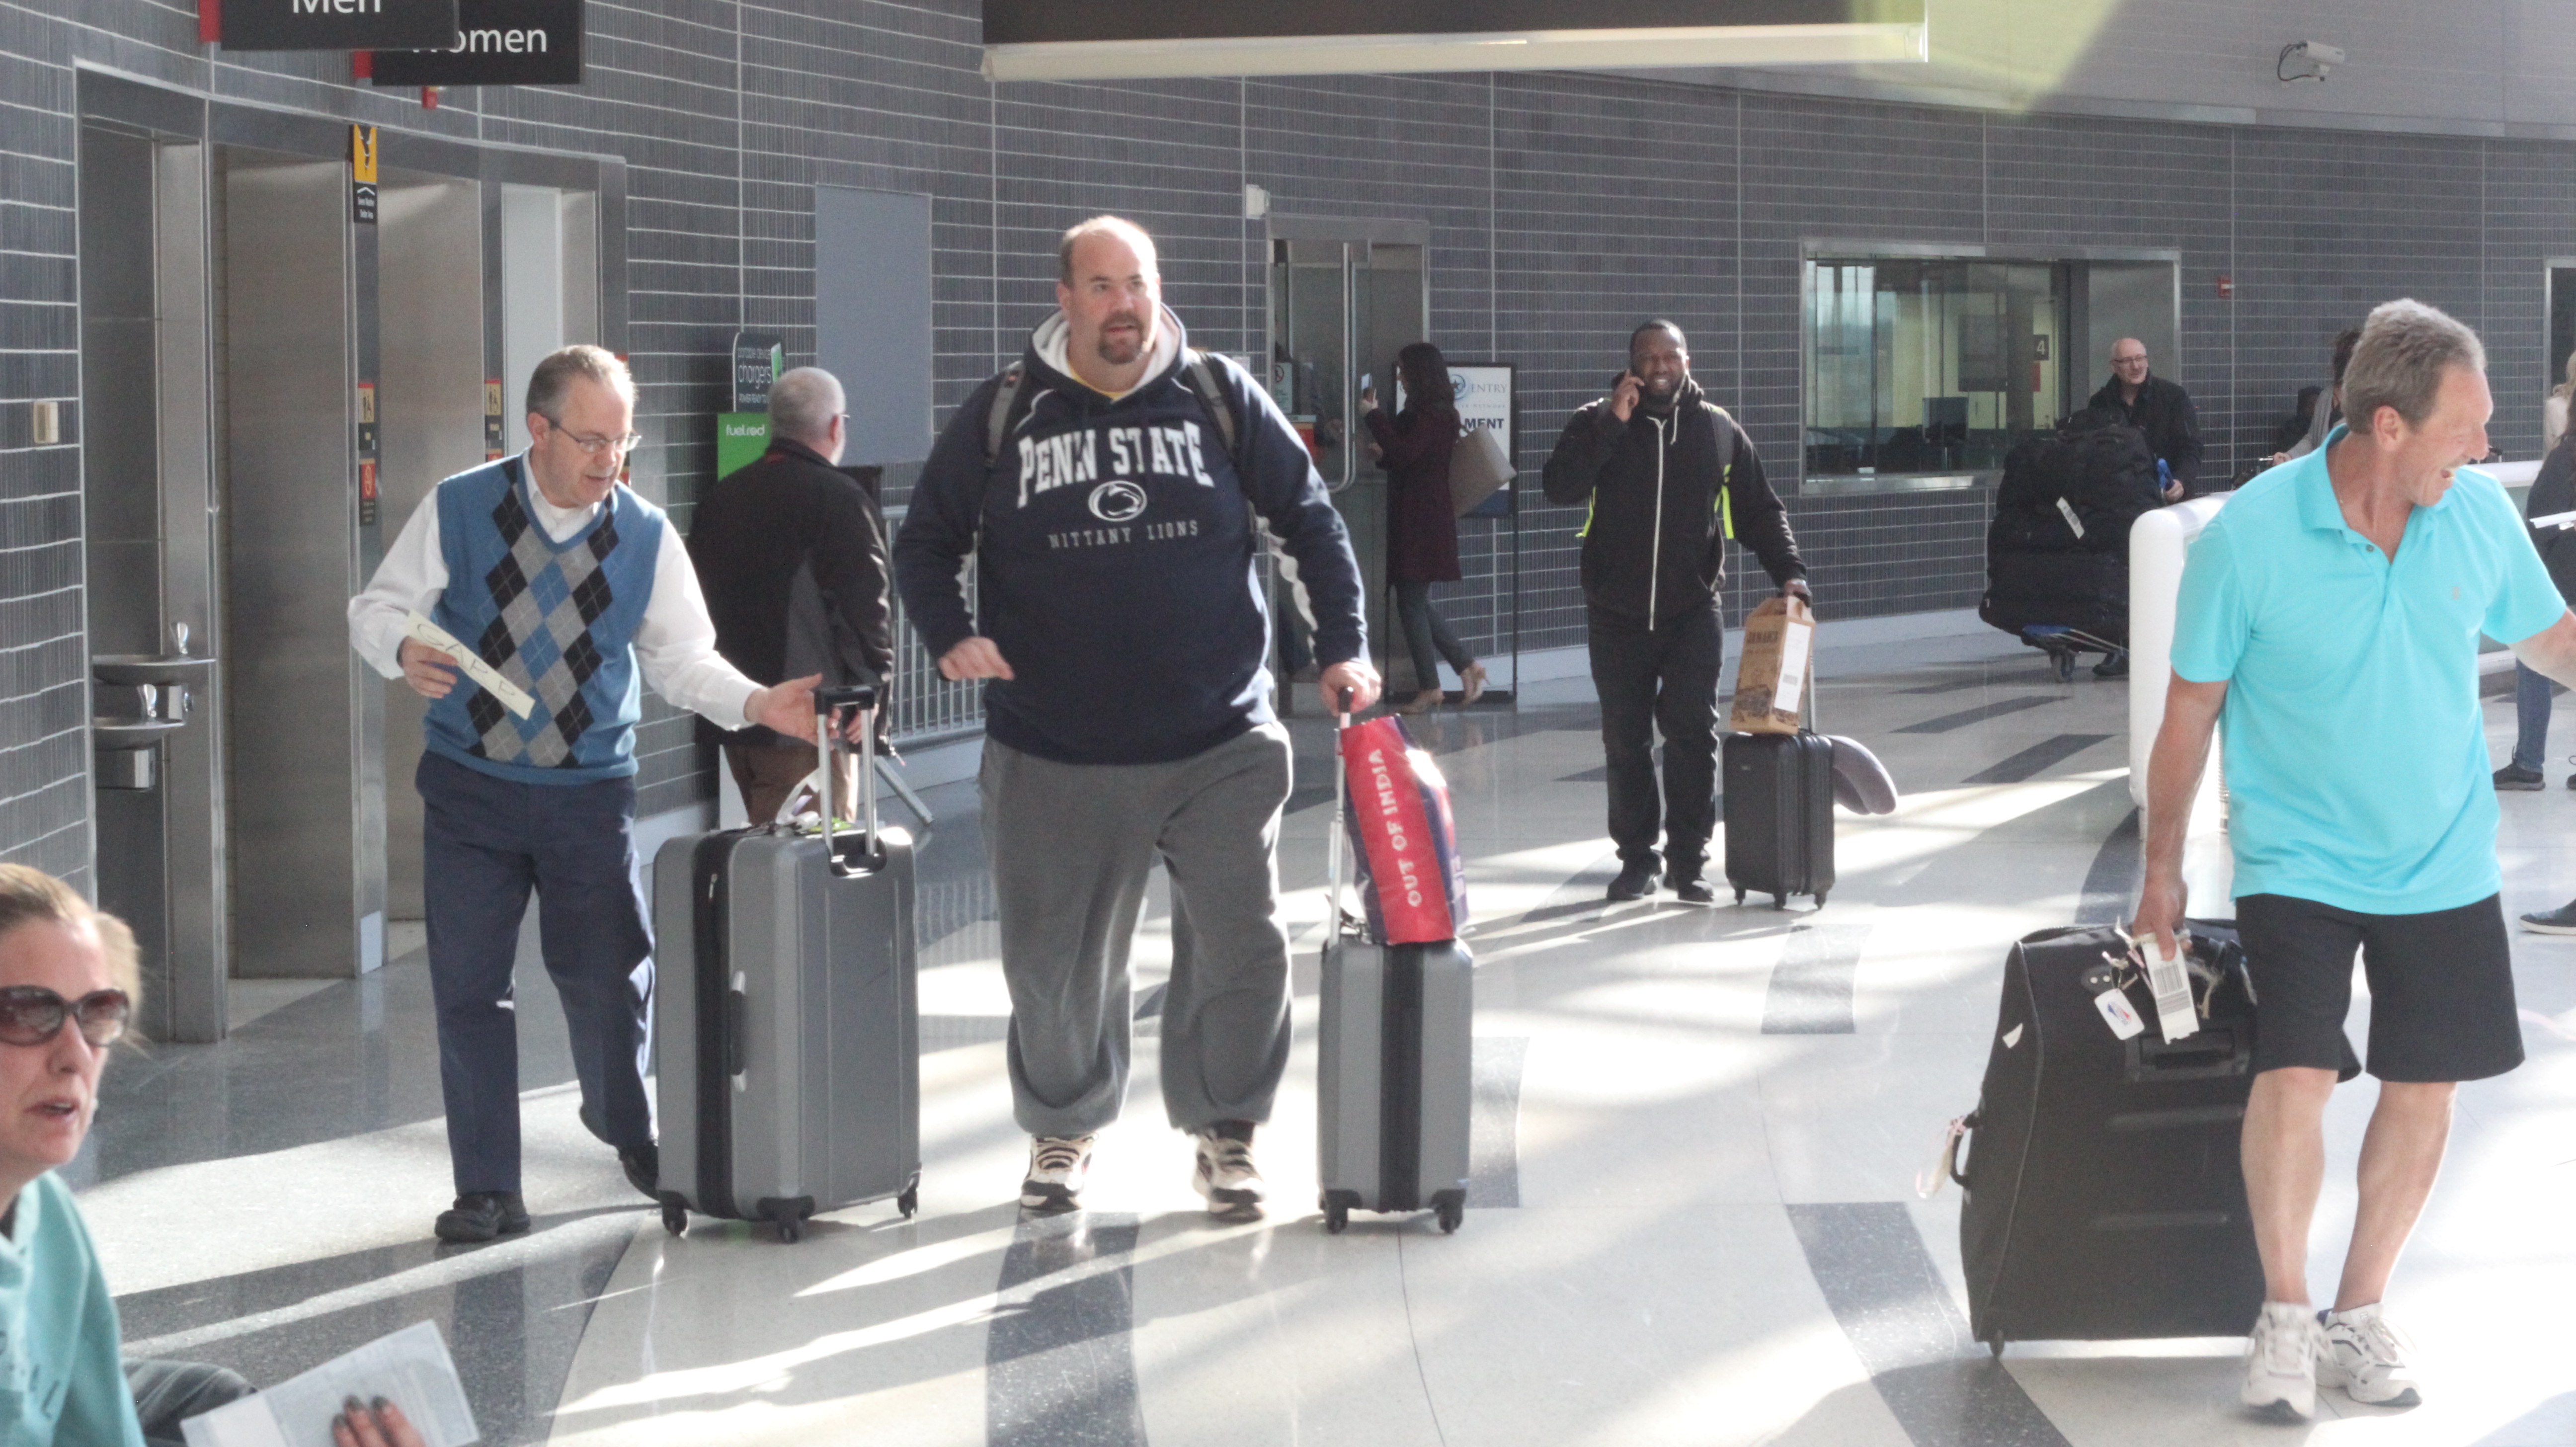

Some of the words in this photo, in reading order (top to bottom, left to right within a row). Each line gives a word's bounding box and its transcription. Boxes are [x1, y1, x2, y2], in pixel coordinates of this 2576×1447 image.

[413, 29, 547, 53] omen
[2037, 340, 2046, 355] 4
[738, 362, 771, 390] chargers
[1471, 383, 1507, 393] ENTRY
[1017, 429, 1098, 509] PENN
[1108, 420, 1215, 488] STATE
[1047, 527, 1131, 549] NITTANY
[1147, 519, 1199, 541] LIONS
[1368, 748, 1398, 815] INDIA
[1386, 820, 1407, 851] OF
[1397, 859, 1422, 907] OUT
